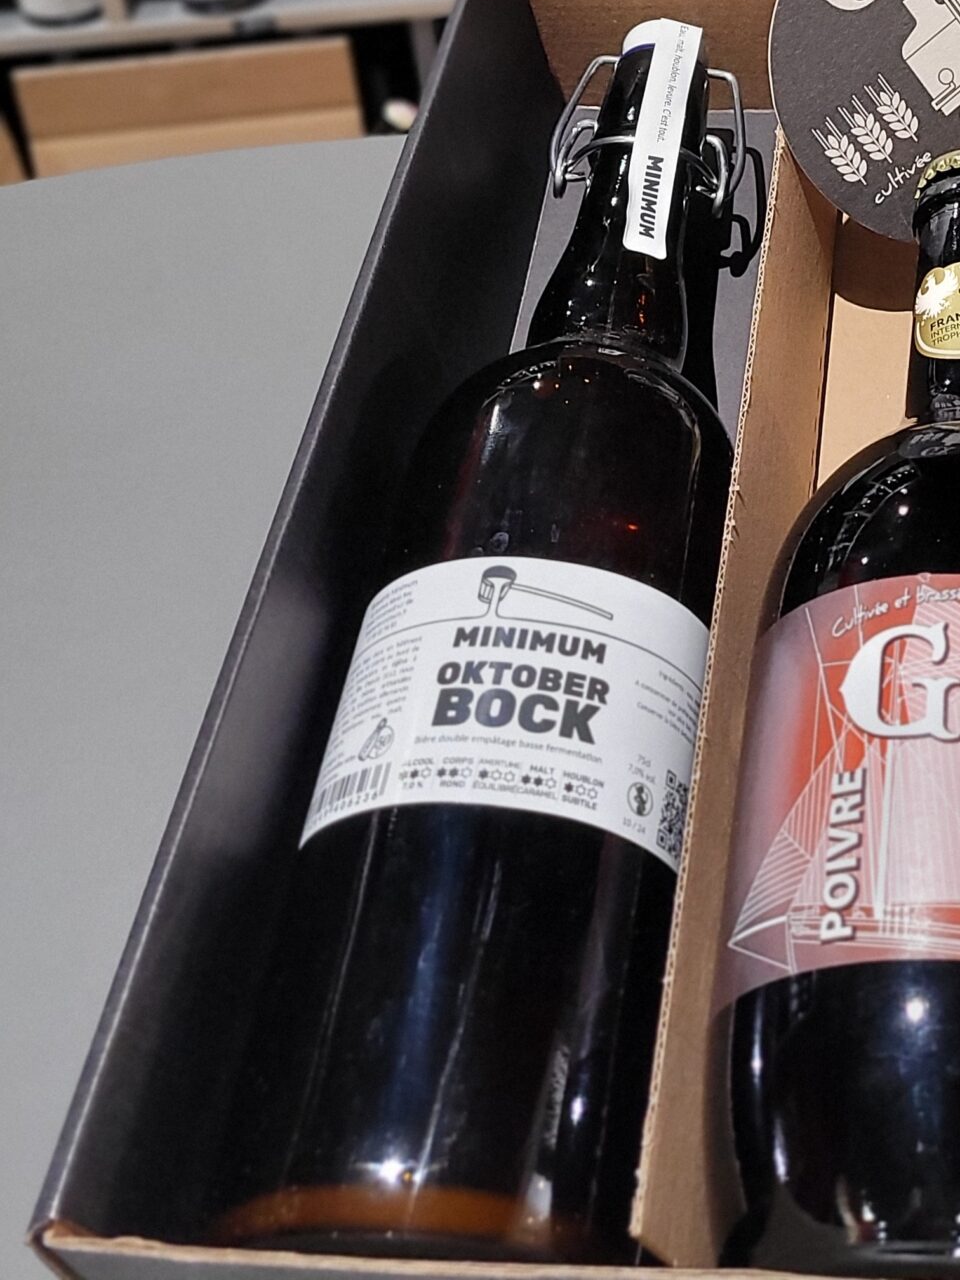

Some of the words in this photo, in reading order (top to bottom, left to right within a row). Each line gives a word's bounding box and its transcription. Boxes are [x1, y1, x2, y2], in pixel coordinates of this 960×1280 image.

[639, 155, 664, 240] MINIMUM
[874, 152, 933, 205] cultivée
[831, 603, 889, 638] Cultivée
[895, 587, 911, 609] et
[452, 626, 607, 664] MINIMUM
[437, 661, 610, 705] OKTOBER
[431, 686, 600, 744] BOCK
[438, 733, 469, 743] double
[471, 734, 517, 748] empâtage
[519, 738, 543, 750] basse
[546, 743, 602, 764] fermentation
[530, 764, 554, 774] MALT
[562, 770, 605, 788] HOUBLON
[562, 795, 597, 811] SUBTILE
[819, 766, 867, 944] POIVRE
